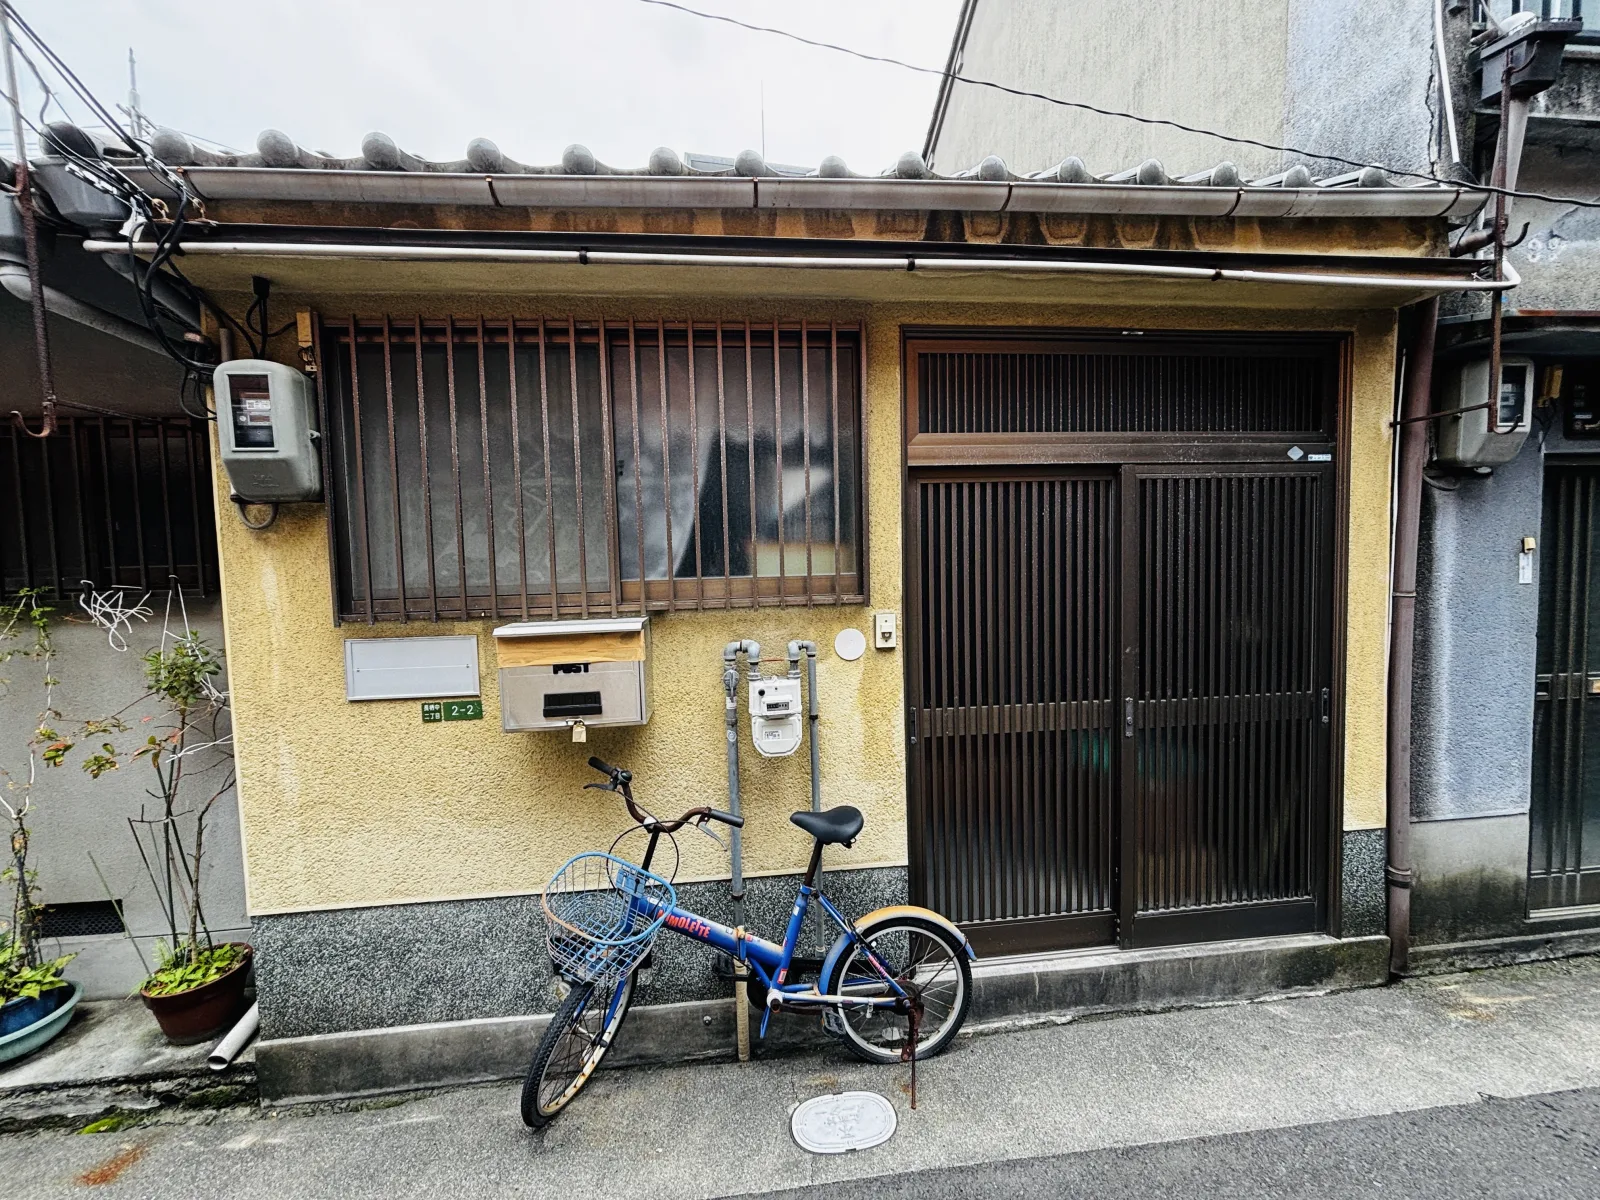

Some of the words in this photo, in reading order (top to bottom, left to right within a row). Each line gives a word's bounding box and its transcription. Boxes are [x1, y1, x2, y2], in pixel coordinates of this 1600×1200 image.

[451, 705, 475, 716] 2-2
[424, 712, 441, 720] 二丁目
